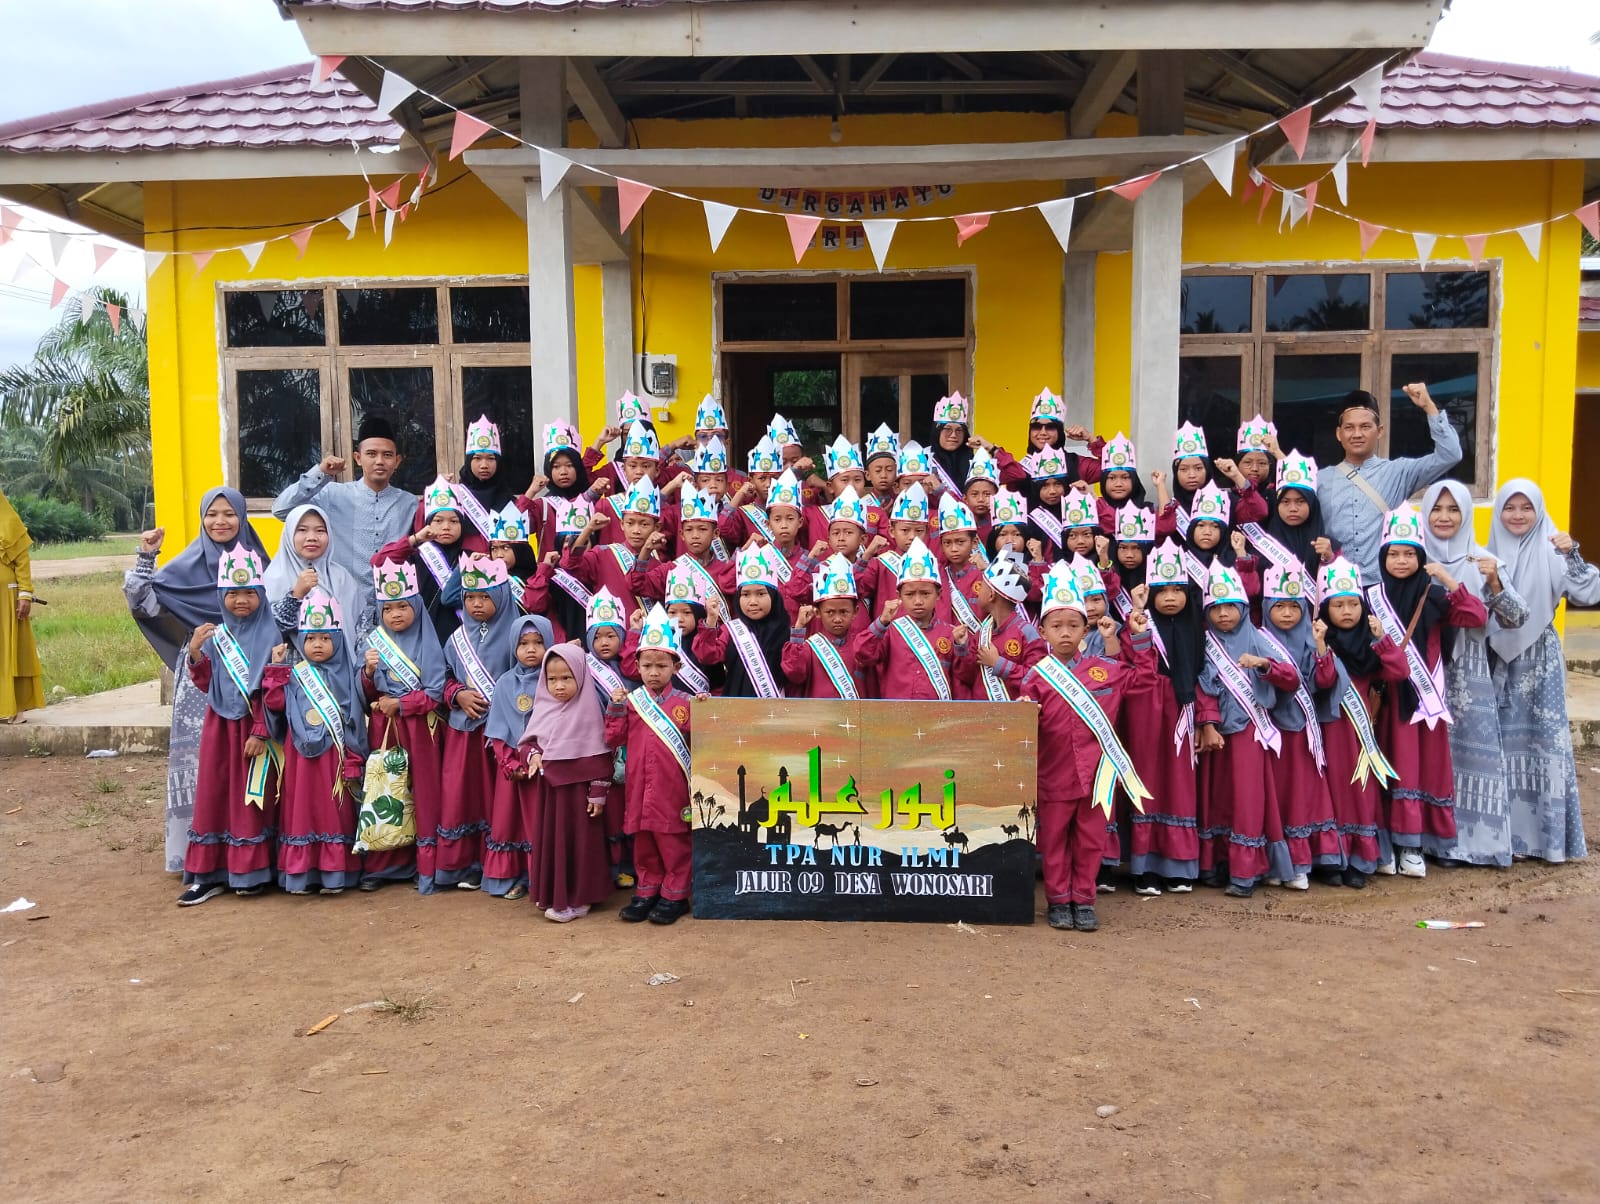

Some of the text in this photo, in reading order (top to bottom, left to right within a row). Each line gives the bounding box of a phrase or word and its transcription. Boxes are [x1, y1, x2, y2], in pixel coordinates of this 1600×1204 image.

[761, 184, 951, 213] DIRGAHAYU
[567, 582, 580, 593] ILMI
[1045, 662, 1057, 675] TPA
[1054, 671, 1068, 687] NUR
[1065, 683, 1080, 698] ILMI
[1080, 700, 1098, 722] JALUR
[1095, 718, 1104, 730] 09
[1100, 728, 1112, 744] DESA
[648, 708, 661, 723] ILMI
[663, 725, 678, 742] JALUR
[871, 769, 958, 831] نور
[765, 844, 960, 868] TPA NUR ILMI
[735, 870, 994, 897] JALUR 09 DESA WONOSARI
